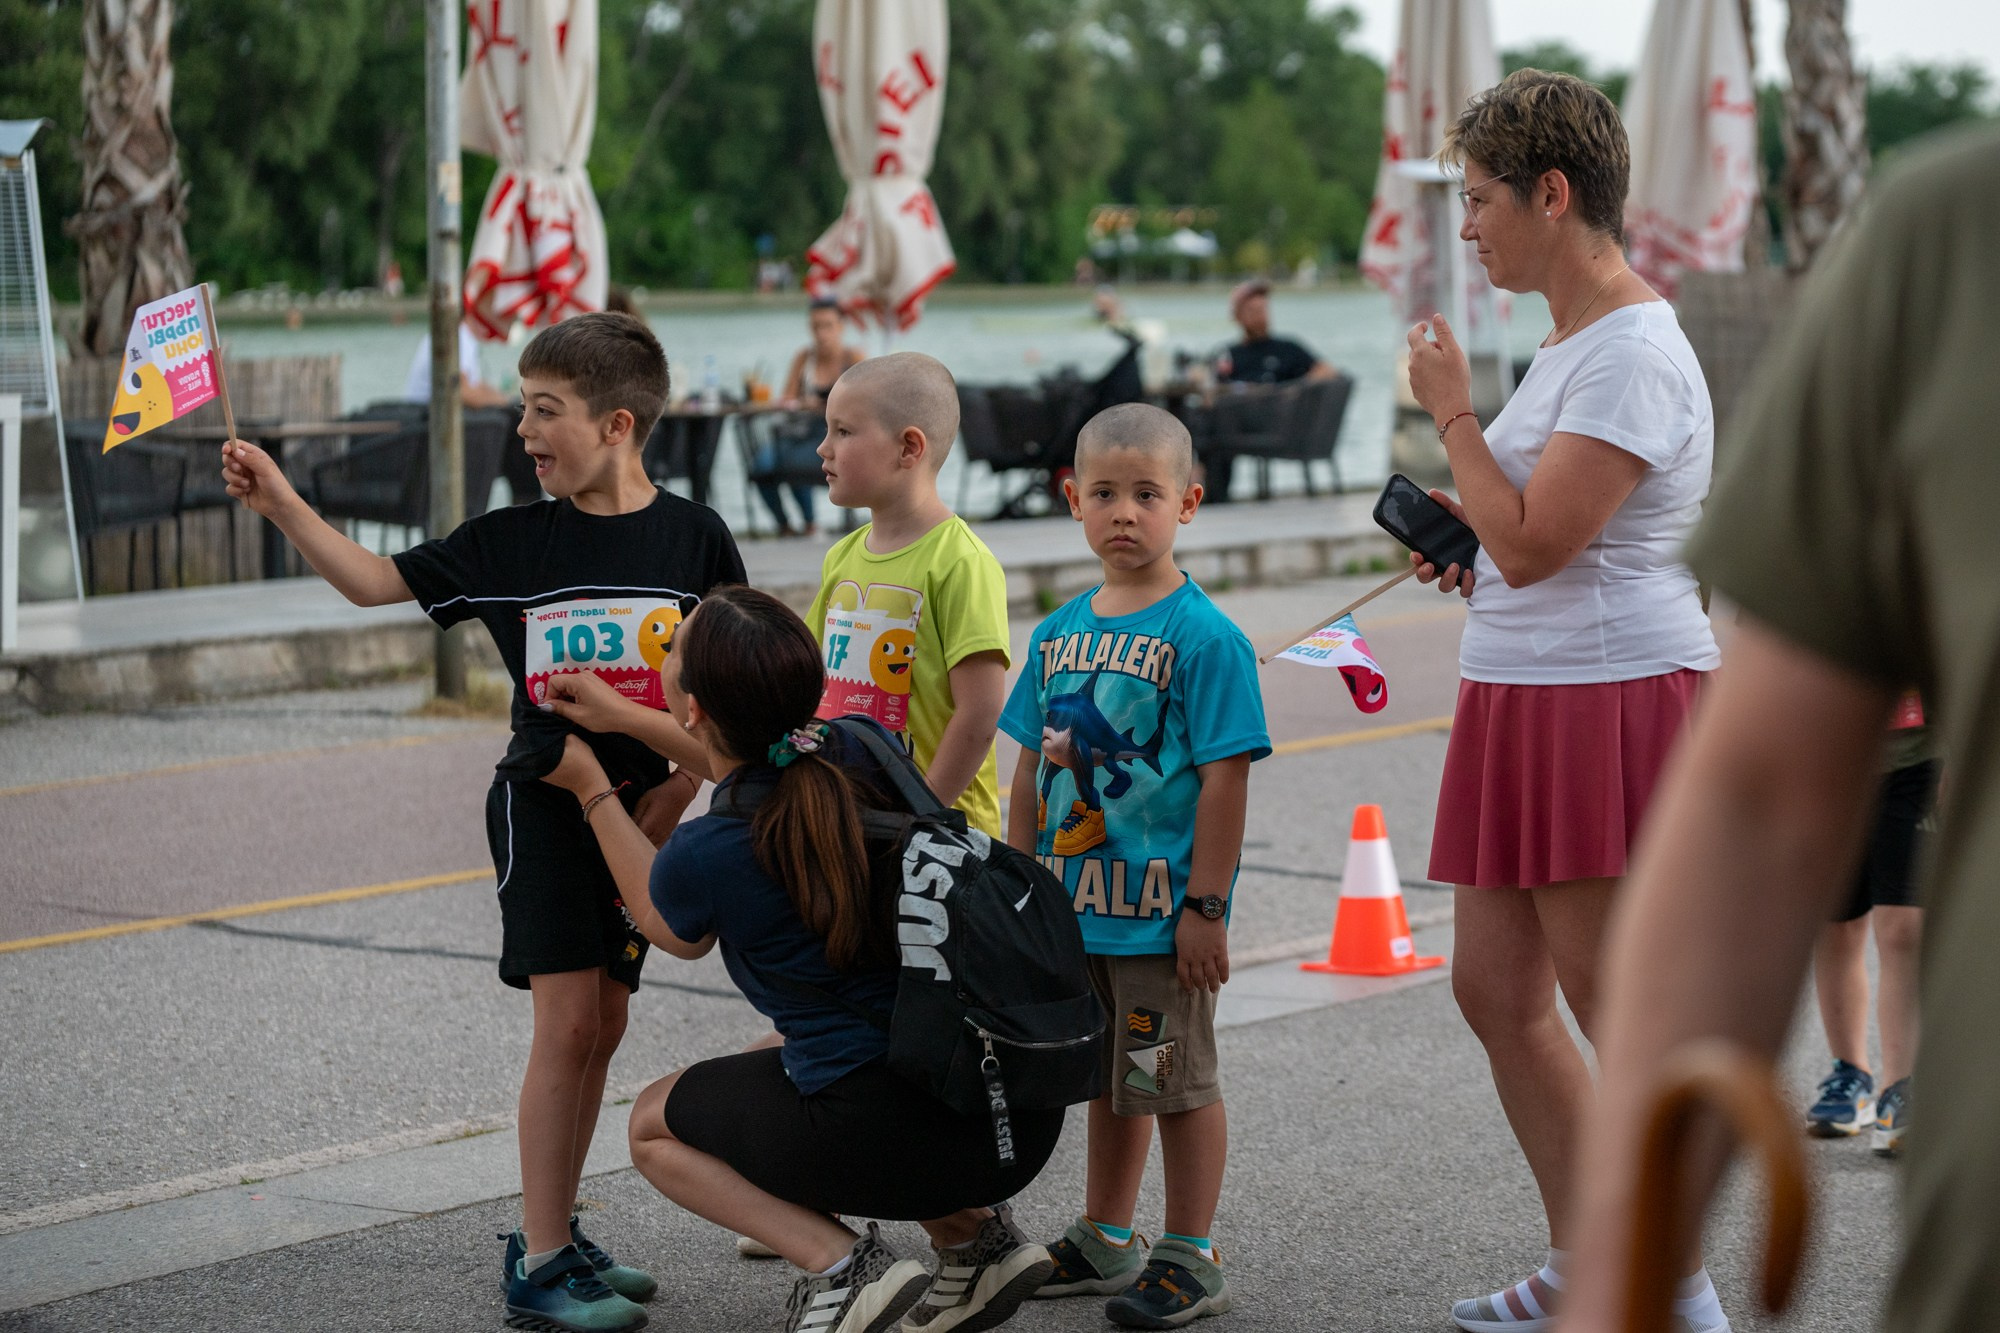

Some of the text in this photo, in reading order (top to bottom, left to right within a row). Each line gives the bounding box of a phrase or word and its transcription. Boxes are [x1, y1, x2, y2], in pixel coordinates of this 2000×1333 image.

[571, 608, 606, 617] първи
[608, 607, 633, 616] юни
[544, 621, 625, 664] 103
[827, 633, 851, 670] 17
[1039, 631, 1176, 691] TRALALERO
[897, 830, 968, 982] JUST
[1156, 1049, 1165, 1091] CHILLED
[1165, 1044, 1173, 1077] SUPER
